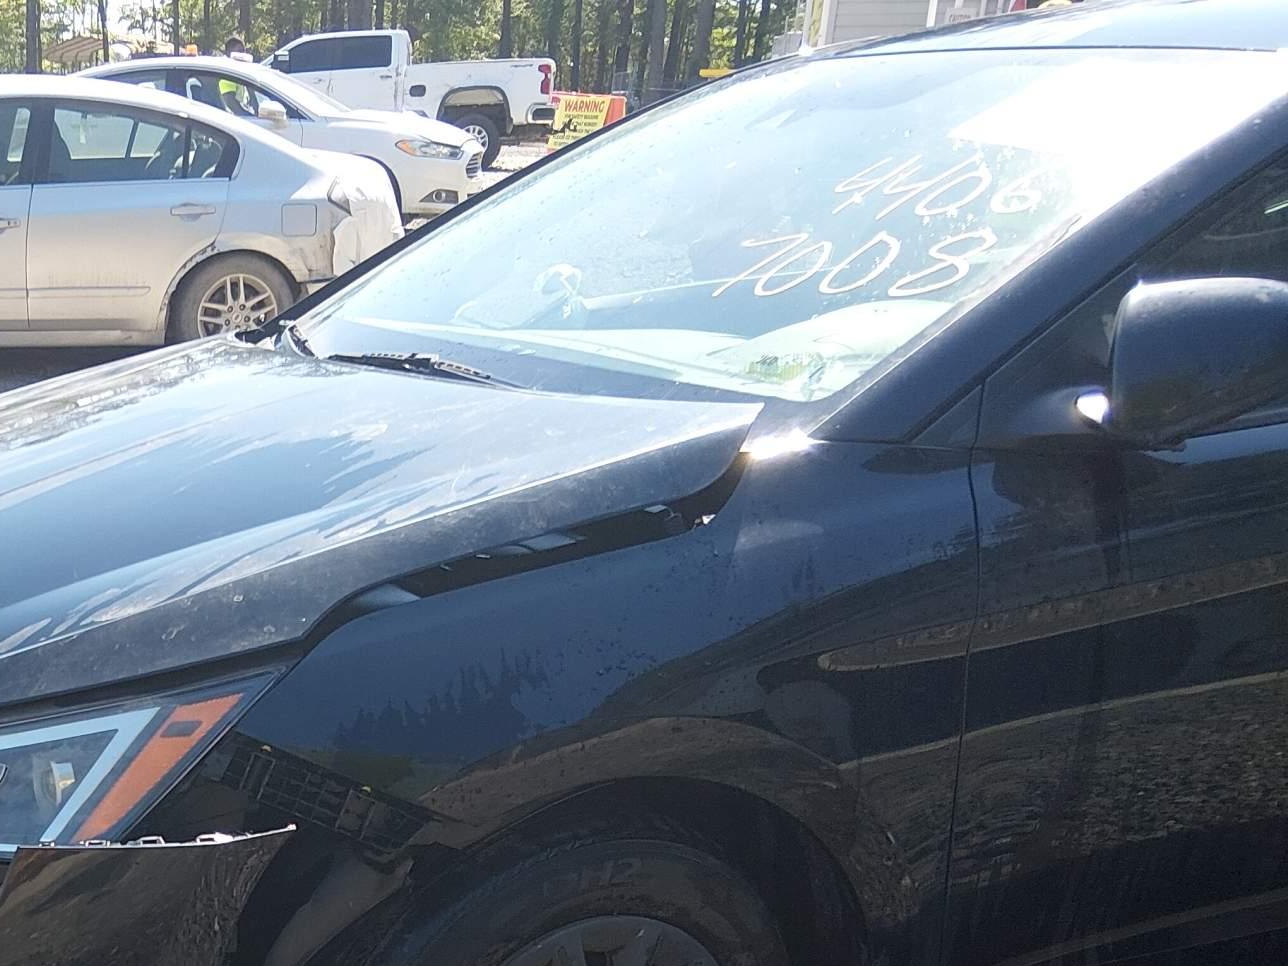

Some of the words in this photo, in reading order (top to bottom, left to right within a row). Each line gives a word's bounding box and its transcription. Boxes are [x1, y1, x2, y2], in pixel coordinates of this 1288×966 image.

[564, 100, 606, 113] WARNING
[831, 153, 1048, 220] 4406
[711, 227, 999, 298] 7008
